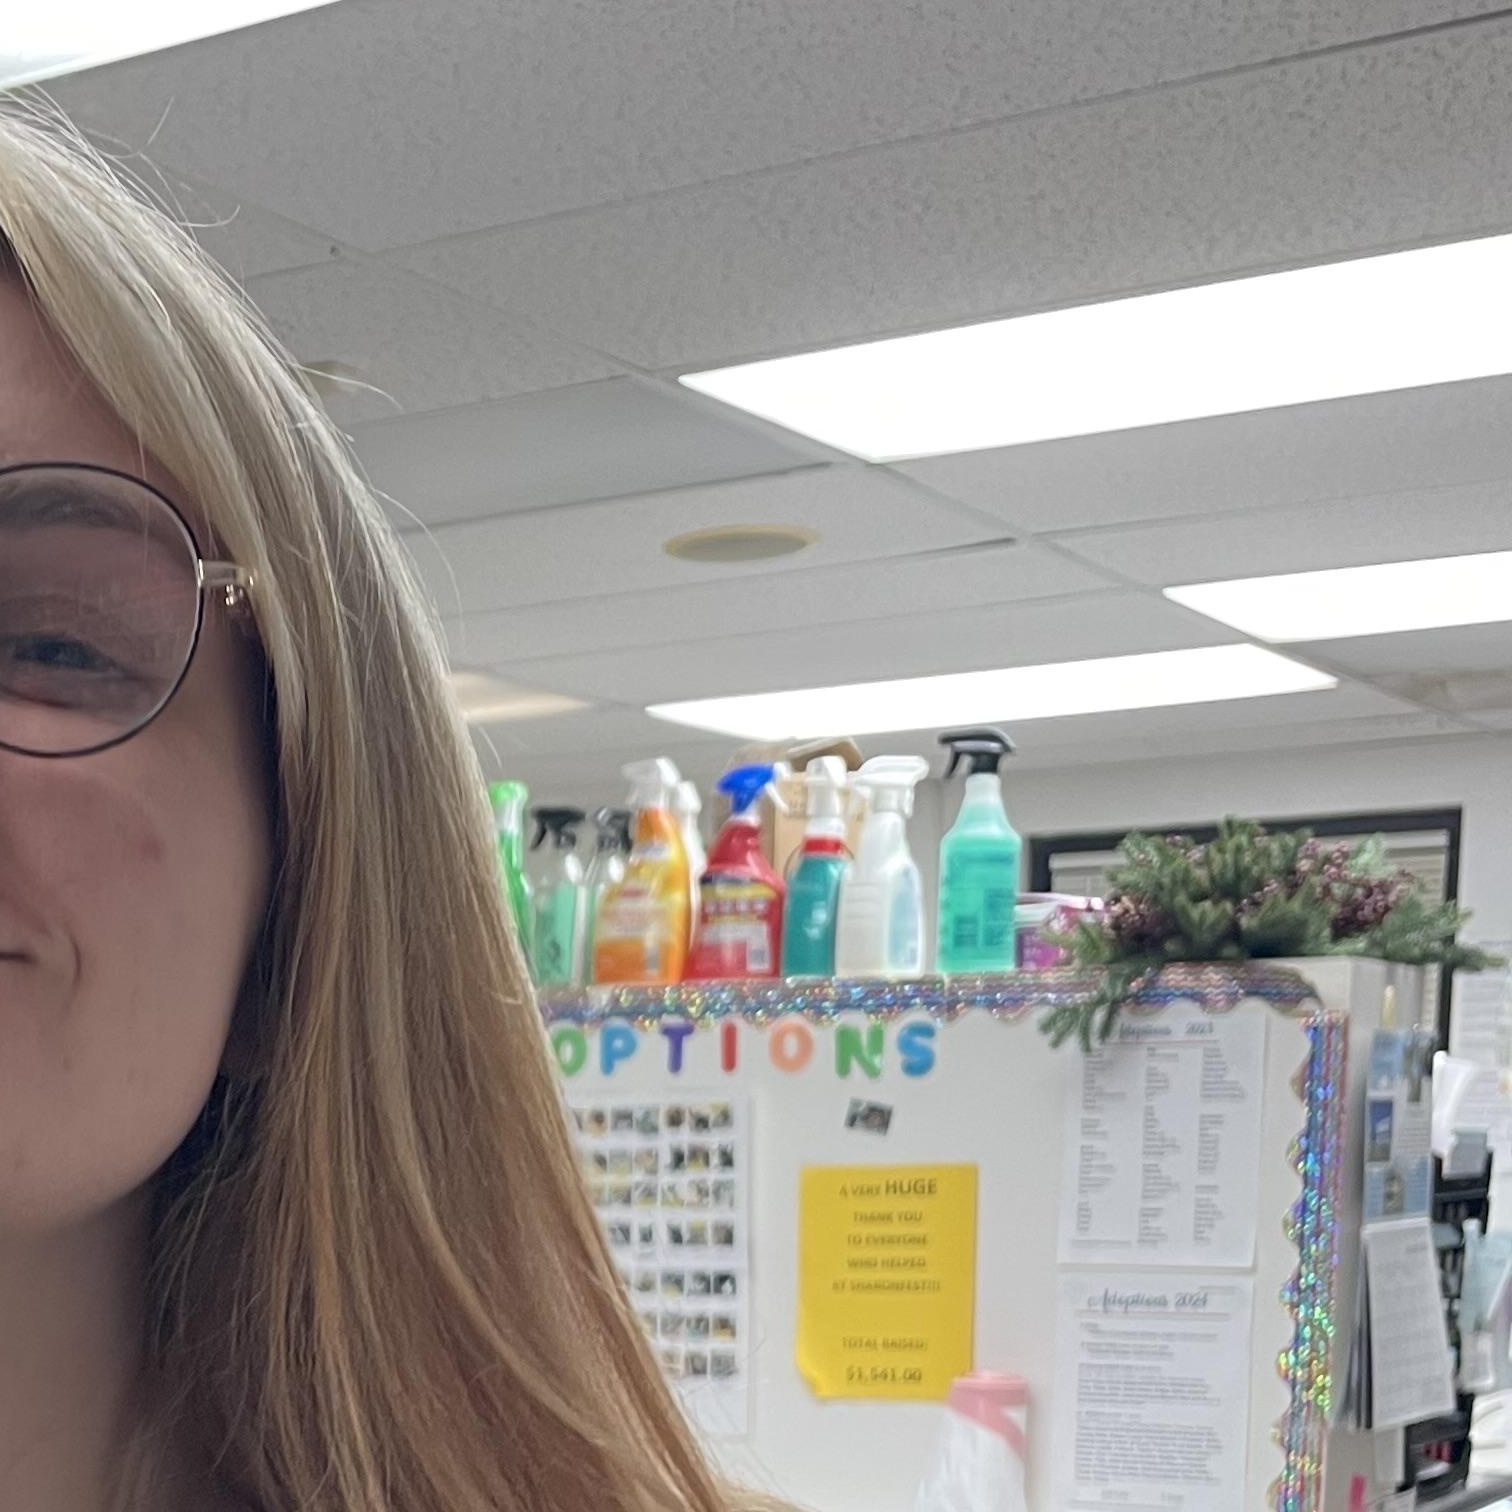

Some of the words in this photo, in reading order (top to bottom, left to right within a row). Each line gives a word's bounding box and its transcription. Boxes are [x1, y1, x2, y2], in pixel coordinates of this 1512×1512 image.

[551, 1020, 937, 1078] OPTIONS
[884, 1177, 938, 1196] HUGE
[853, 1210, 894, 1223] THANK
[897, 1210, 923, 1223] YOU
[847, 1233, 863, 1246] TO
[865, 1233, 929, 1246] EVERYONE
[842, 1336, 878, 1351] TOTAL
